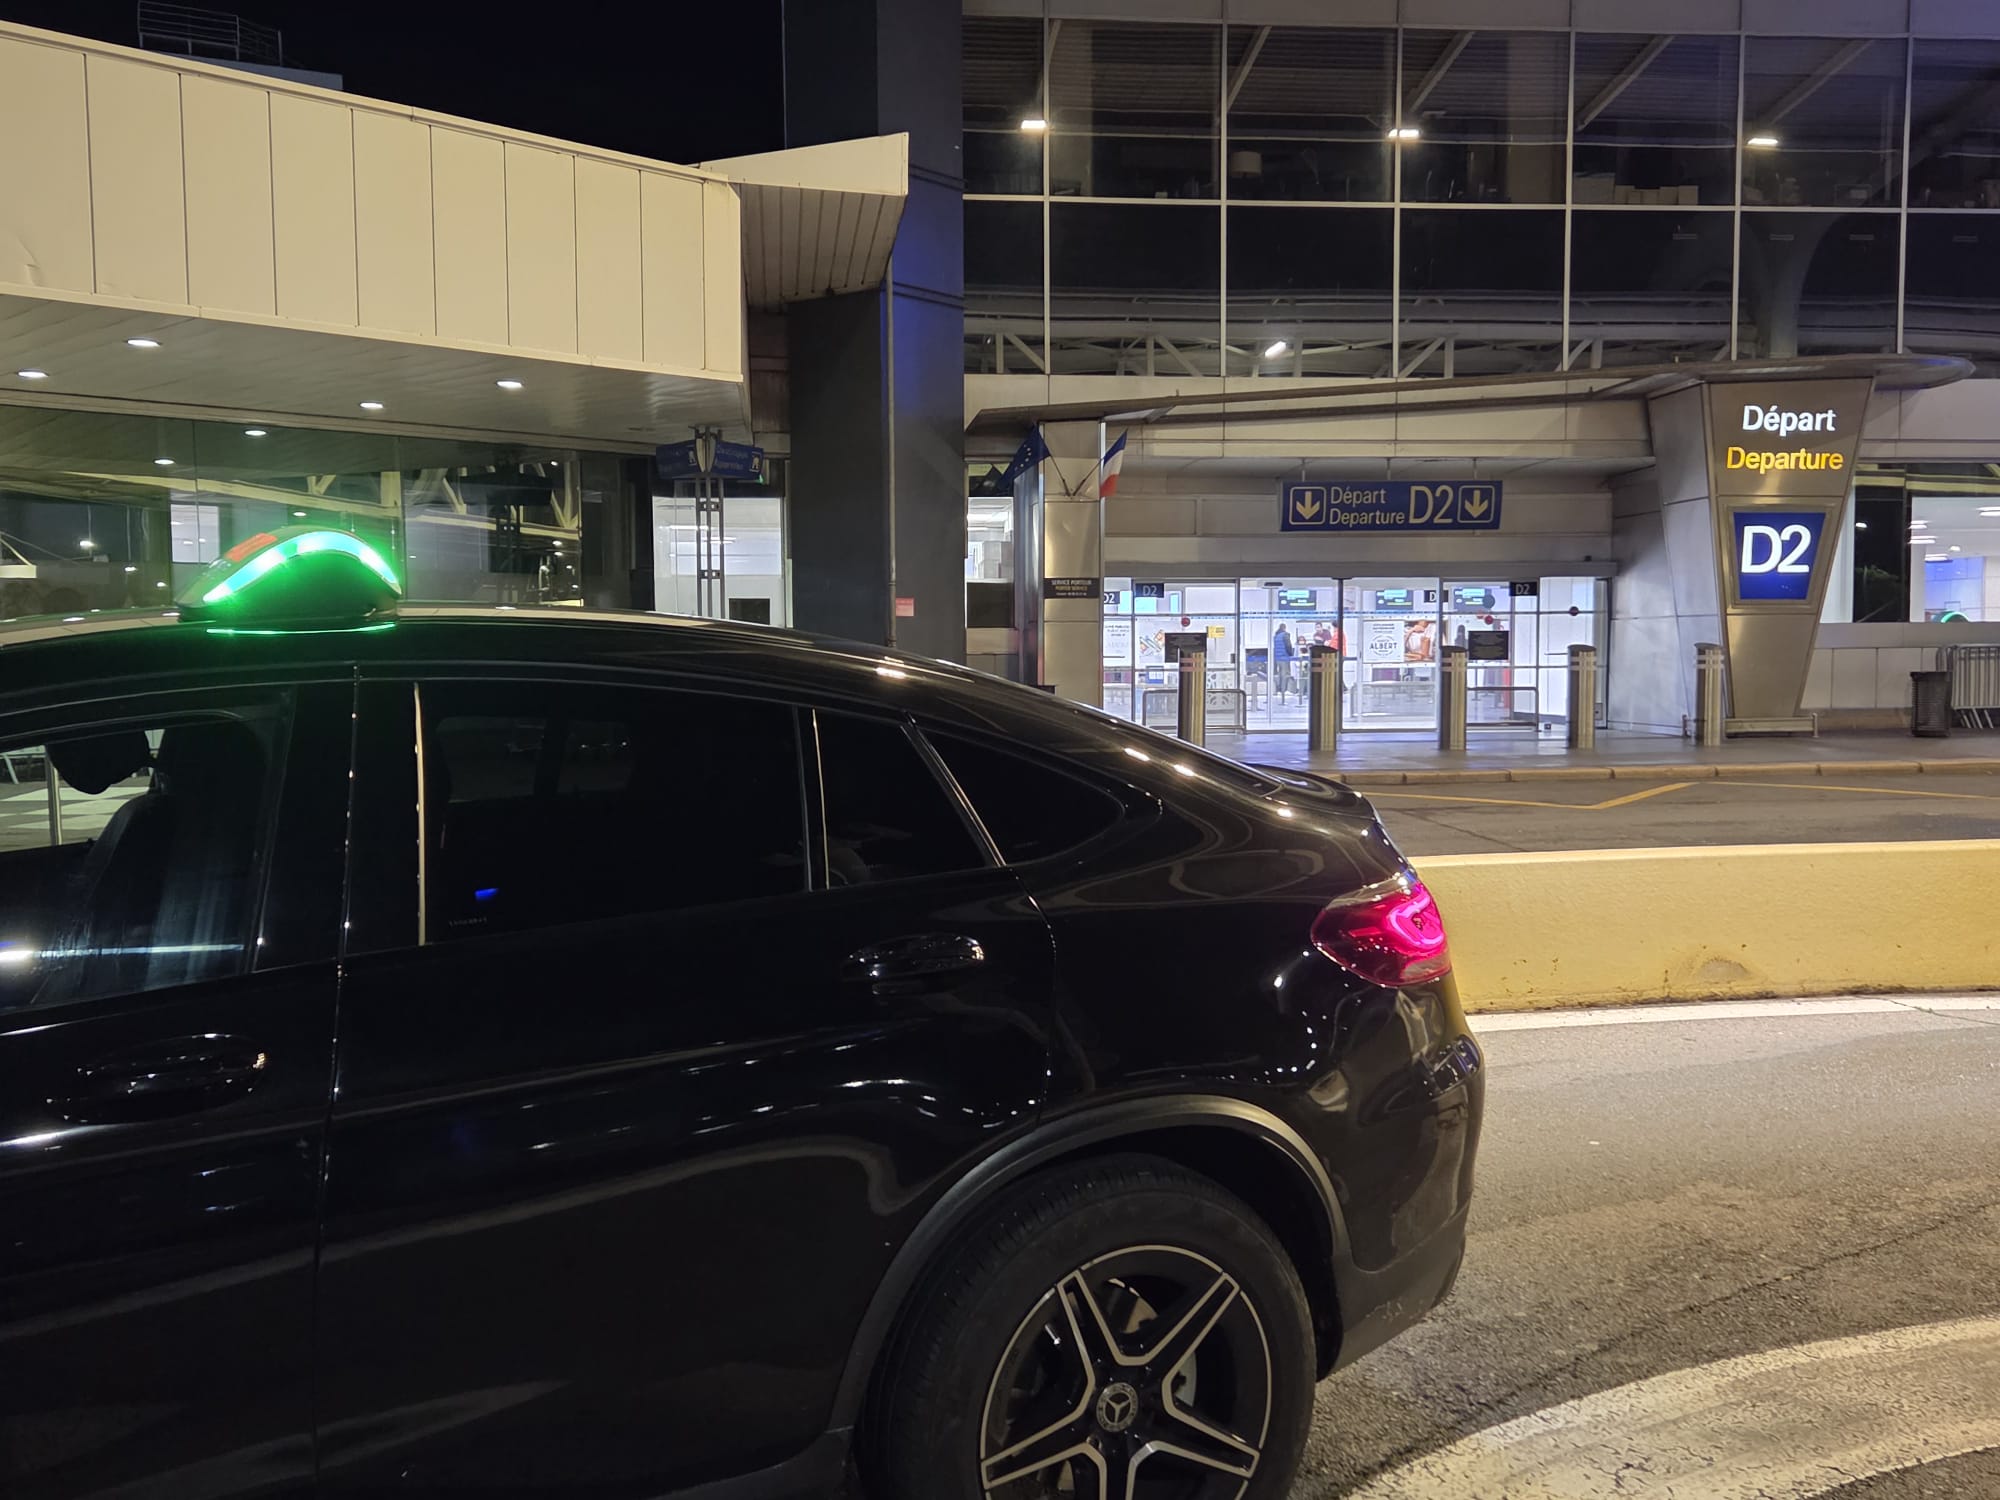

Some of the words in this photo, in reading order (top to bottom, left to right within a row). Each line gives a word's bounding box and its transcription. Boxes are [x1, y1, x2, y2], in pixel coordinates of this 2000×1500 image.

[1742, 405, 1836, 437] Départ
[1727, 446, 1844, 474] Departure
[1330, 485, 1386, 507] Départ
[1409, 485, 1454, 524] D2
[1329, 508, 1405, 527] Departure
[1741, 524, 1811, 574] D2
[1142, 585, 1158, 597] D2
[1515, 583, 1530, 595] D2
[1369, 642, 1398, 650] ALBERT
